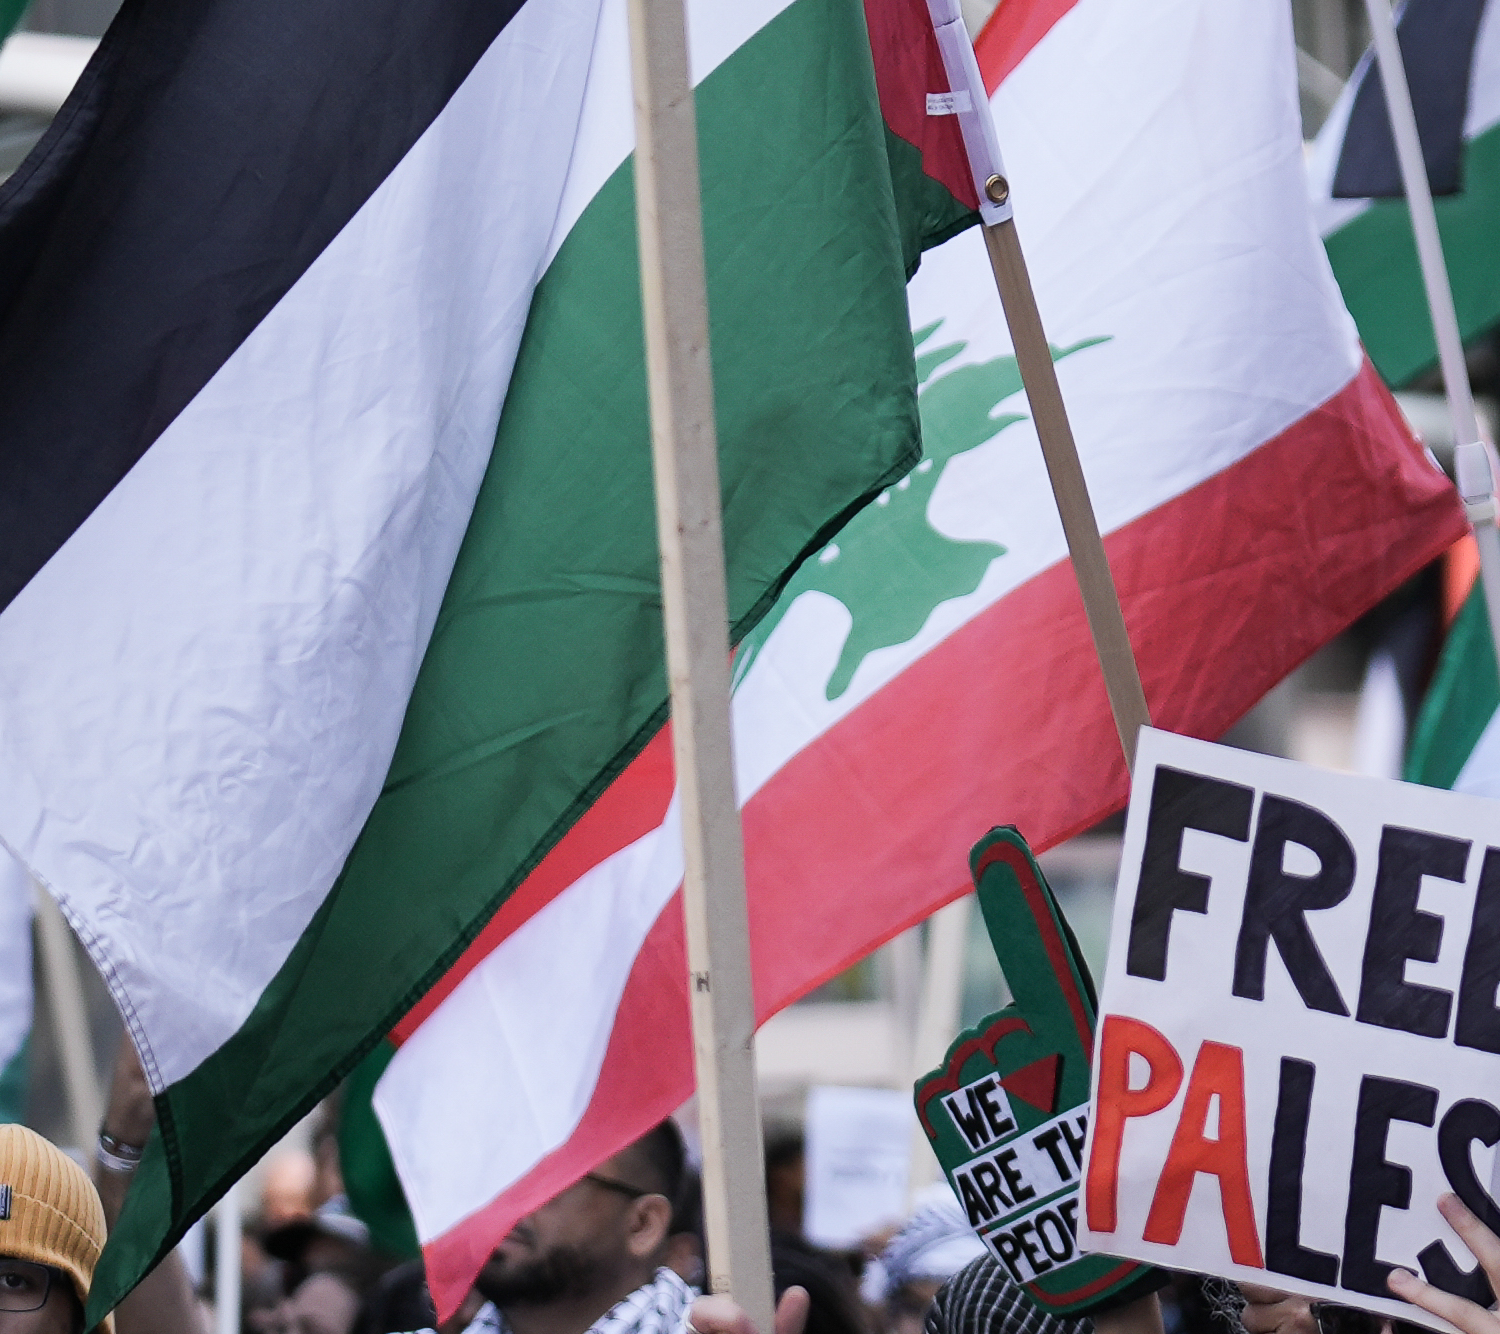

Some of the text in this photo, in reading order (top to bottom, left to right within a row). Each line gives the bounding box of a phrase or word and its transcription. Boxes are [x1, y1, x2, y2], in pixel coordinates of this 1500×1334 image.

[947, 1081, 1016, 1149] WE
[957, 1107, 1090, 1227] ARE TH
